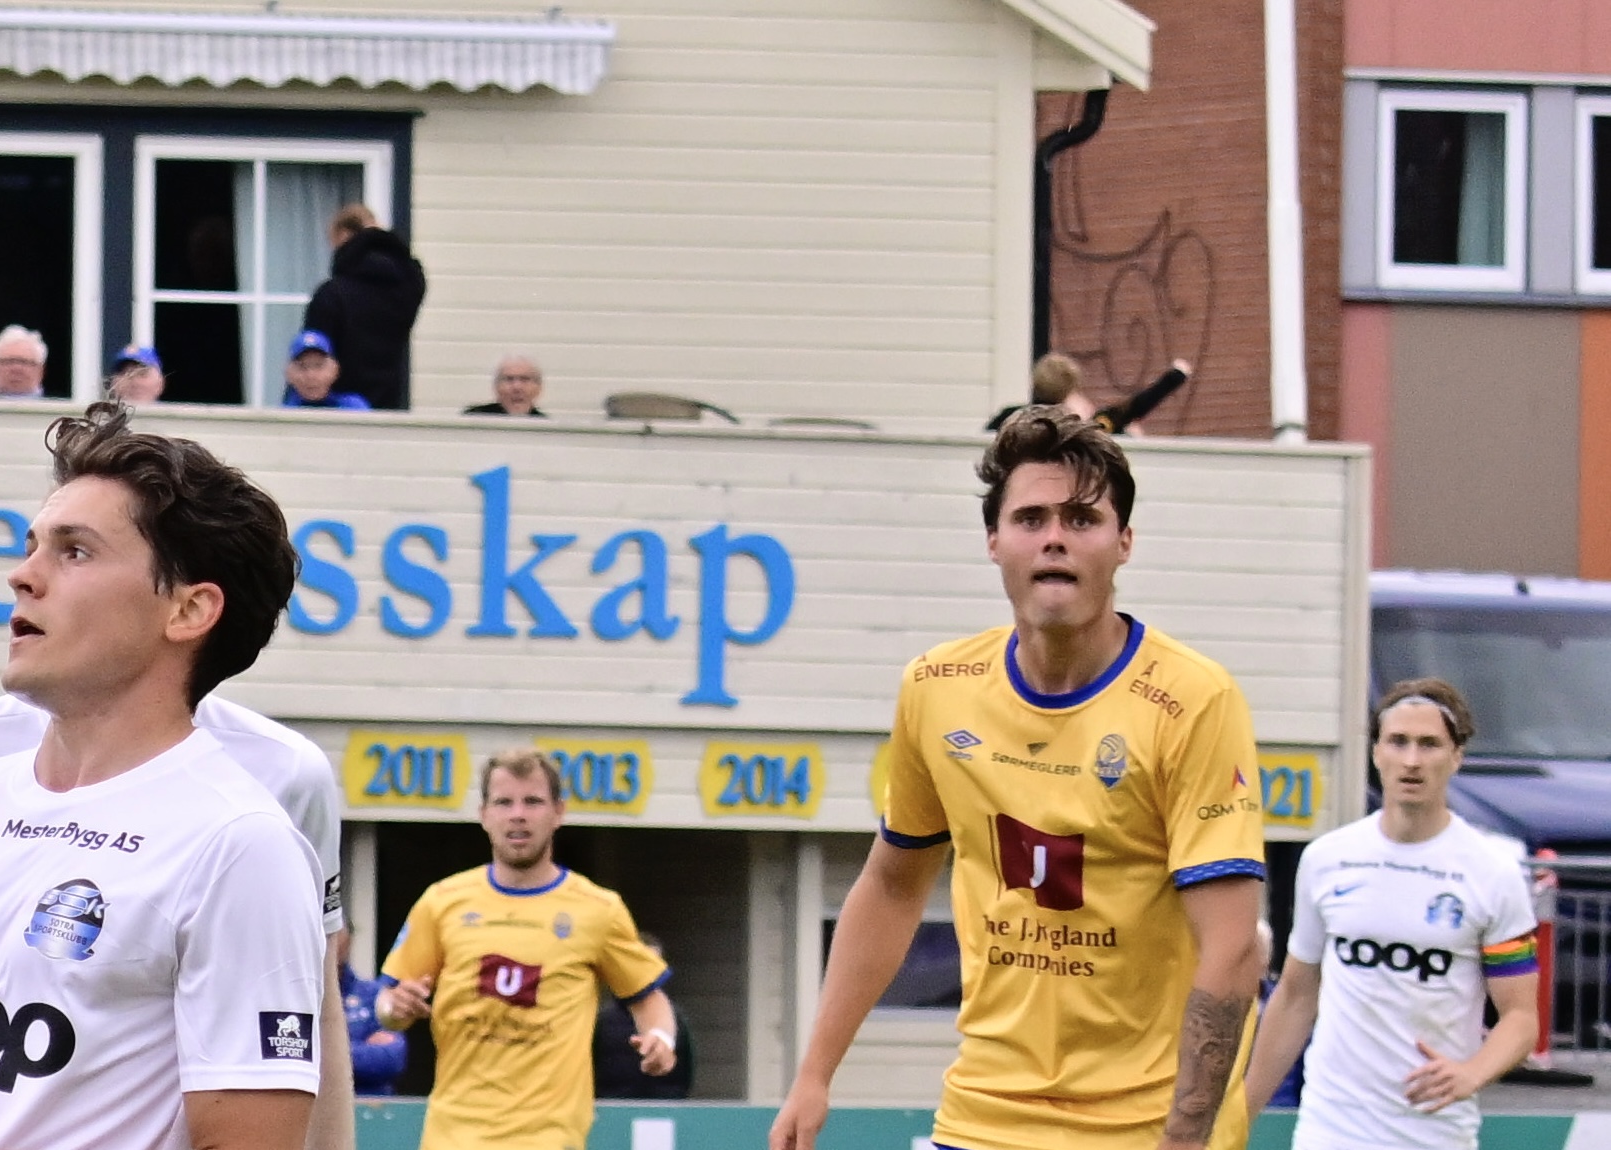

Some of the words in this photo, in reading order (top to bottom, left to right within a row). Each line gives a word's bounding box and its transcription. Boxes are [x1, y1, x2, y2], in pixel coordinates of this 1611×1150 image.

[914, 661, 991, 683] ENERGI
[1128, 679, 1184, 720] ENERGI
[365, 742, 454, 798] 2011
[550, 749, 642, 804] 2013
[716, 752, 812, 806] 2014
[1197, 803, 1235, 820] OSM
[1, 819, 109, 851] MesterBygg
[109, 832, 145, 853] AS
[48, 917, 75, 931] SOTRA
[1336, 935, 1453, 983] coop
[495, 965, 523, 996] U
[267, 1036, 309, 1050] TORSHOV
[276, 1047, 304, 1058] SPORT
